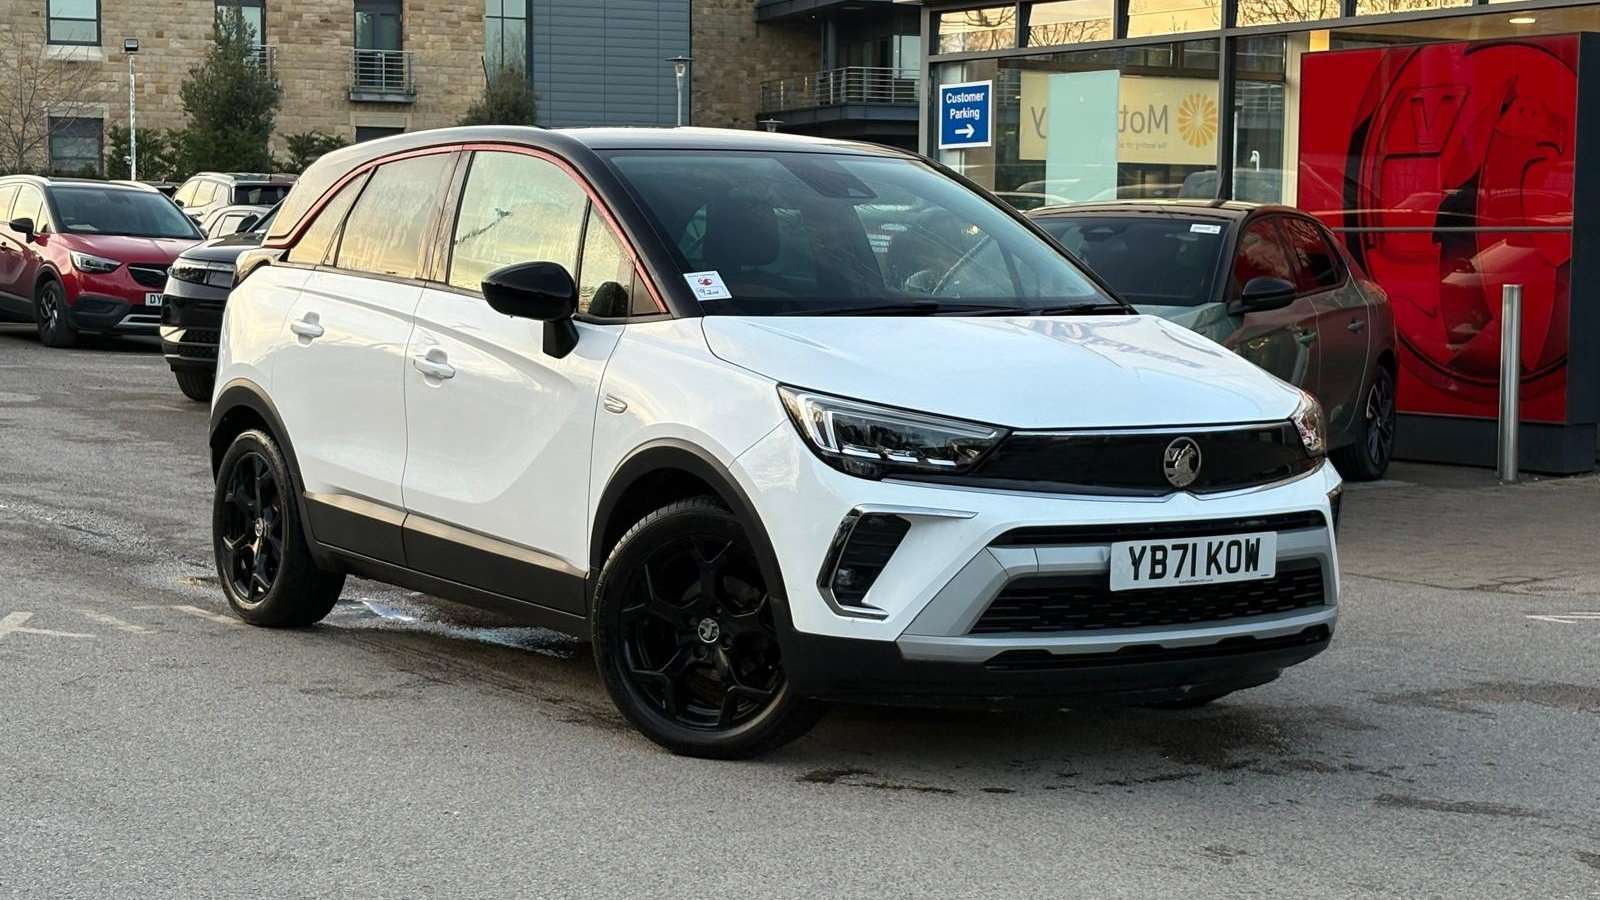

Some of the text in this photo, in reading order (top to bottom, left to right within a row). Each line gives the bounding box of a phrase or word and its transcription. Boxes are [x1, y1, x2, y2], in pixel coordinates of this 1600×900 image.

[945, 92, 985, 104] Customer
[949, 107, 980, 120] Parking
[1128, 537, 1261, 581] YB71 KOW
